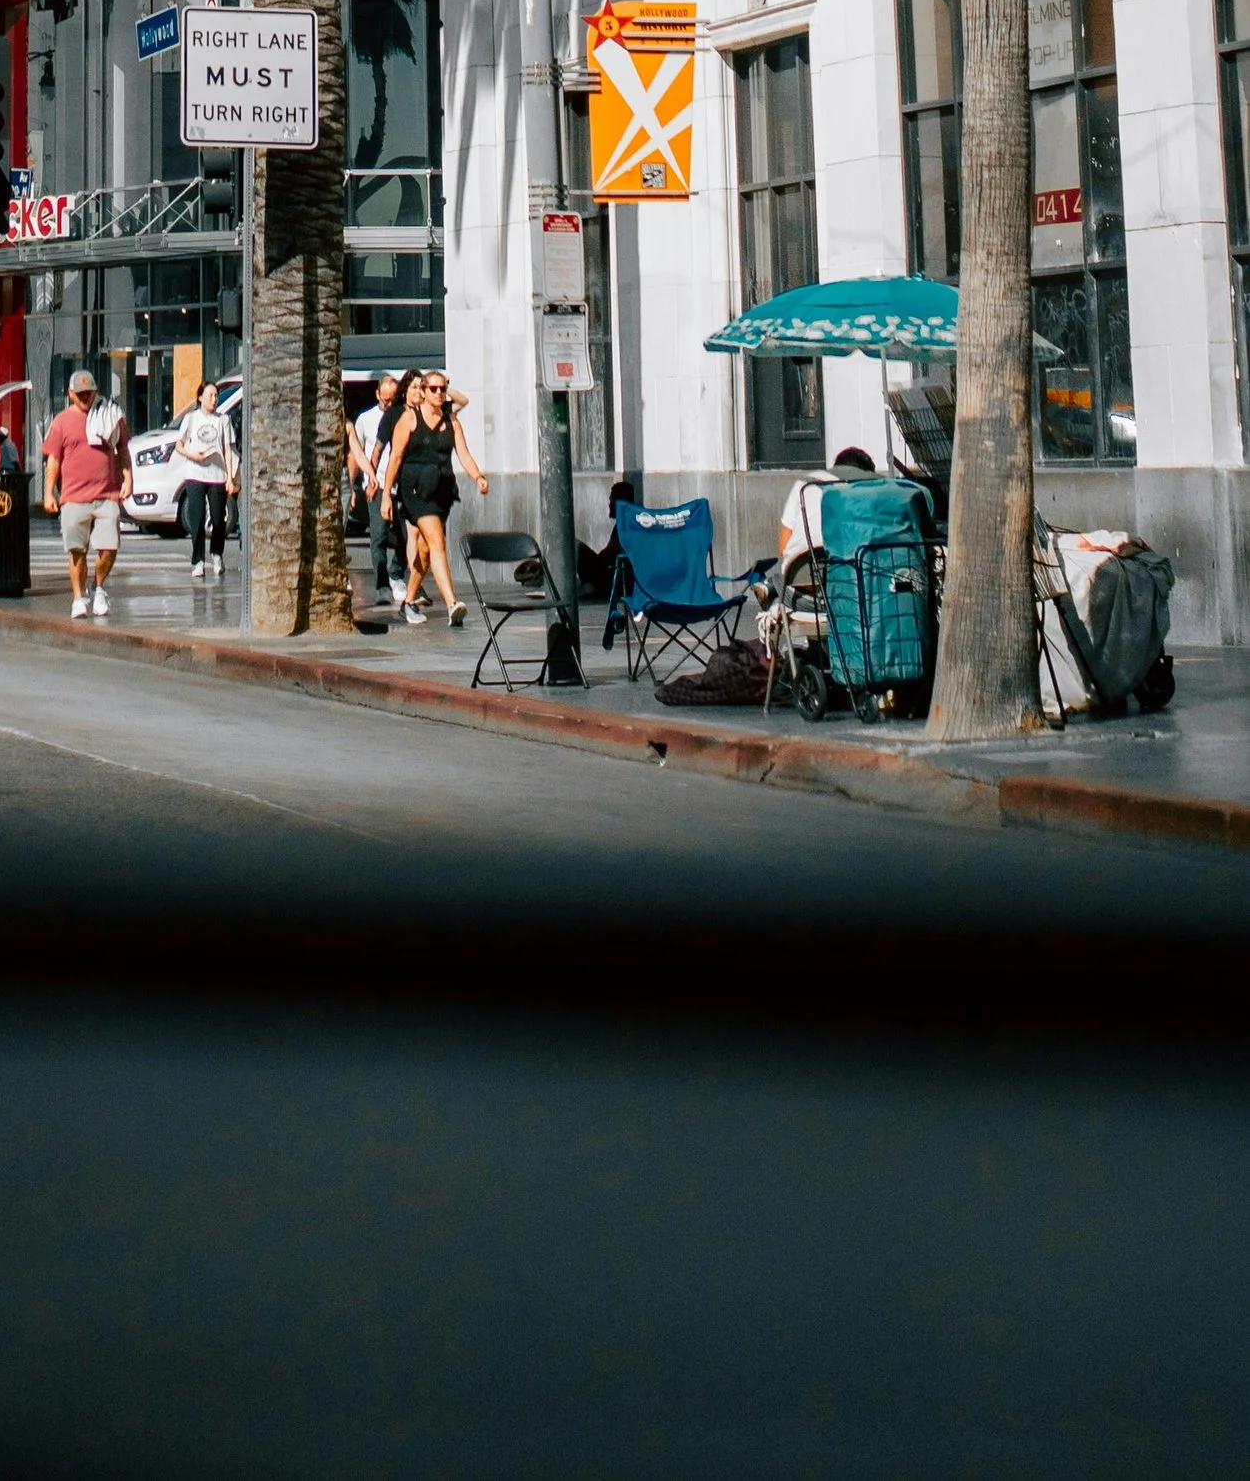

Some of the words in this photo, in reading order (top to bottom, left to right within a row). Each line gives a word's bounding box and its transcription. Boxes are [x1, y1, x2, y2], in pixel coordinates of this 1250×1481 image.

[640, 7, 688, 18] HOLLYWOOD
[192, 30, 249, 48] RIGHT
[257, 32, 308, 51] LANE
[206, 65, 294, 89] MUST
[191, 103, 243, 122] TURN
[252, 105, 309, 124] RIGHT
